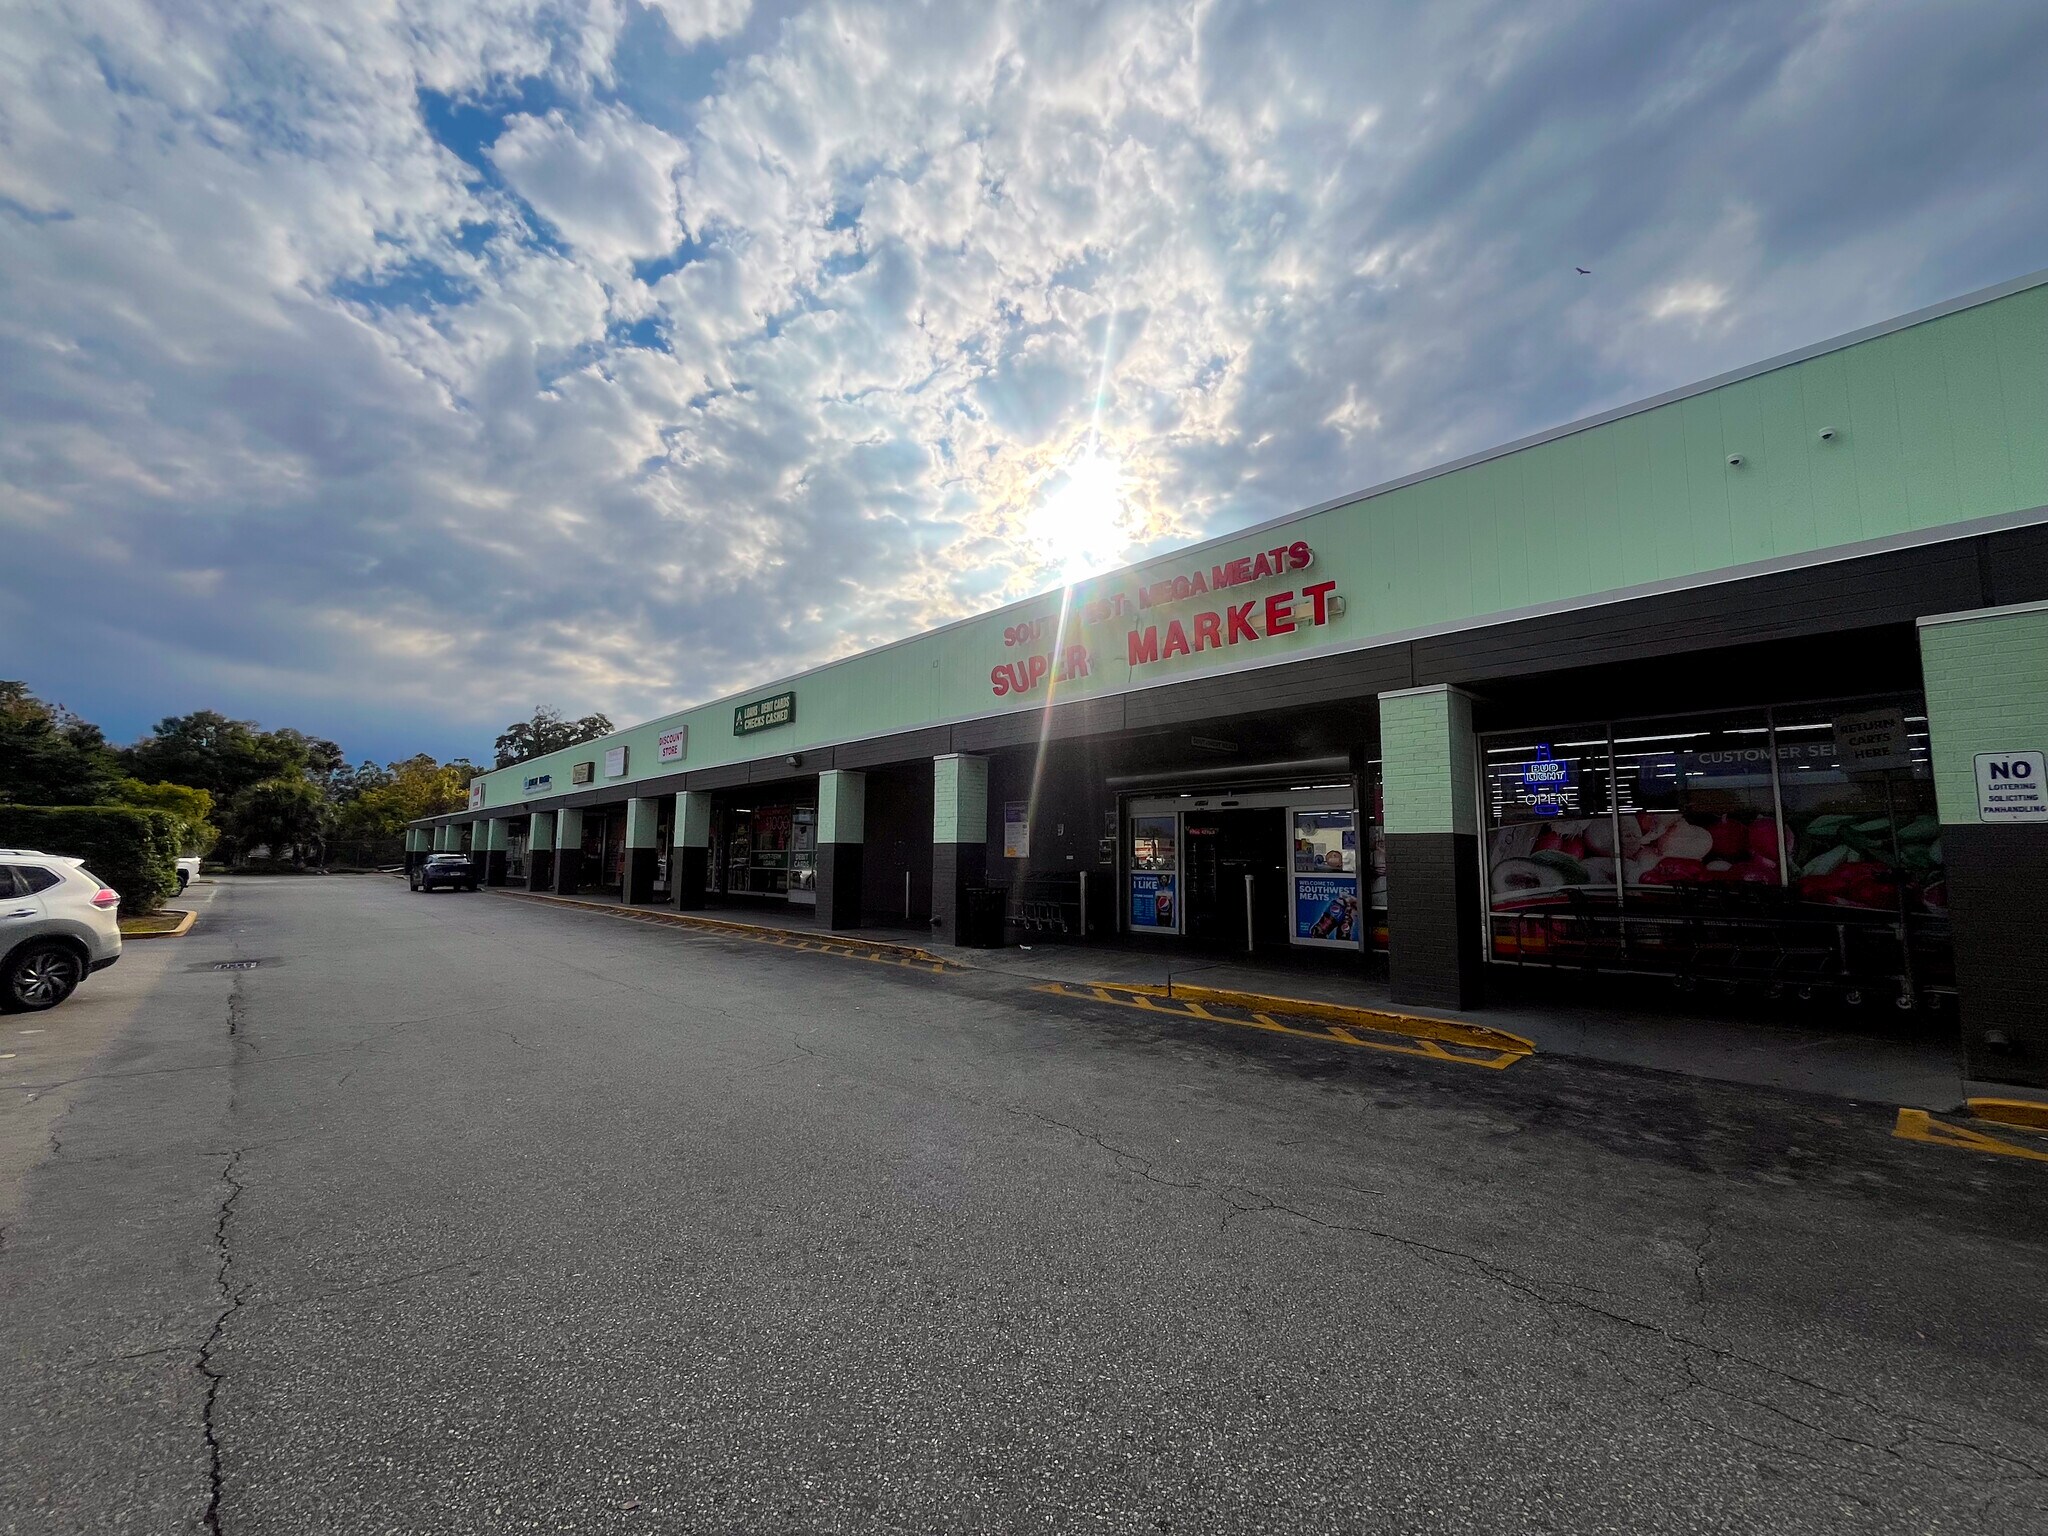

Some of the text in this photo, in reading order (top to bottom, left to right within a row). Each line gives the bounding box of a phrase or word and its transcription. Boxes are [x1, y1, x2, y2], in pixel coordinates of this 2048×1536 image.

[1139, 570, 1210, 610] MEGA
[1212, 541, 1313, 589] MEATS
[990, 581, 1336, 696] SUPER MARKET
[744, 709, 788, 730] CHECKS CASHED
[1839, 718, 1896, 734] RETURN
[659, 731, 683, 746] DISCOUNT
[1848, 732, 1892, 747] CARTS
[662, 745, 678, 757] STORE
[1854, 746, 1891, 760] HERE
[1531, 763, 1559, 773] BUD
[1989, 760, 2032, 780] NO
[1525, 772, 1565, 782] LIGHT
[1988, 782, 2037, 791] LOITERING
[1525, 793, 1569, 806] OPEN
[1988, 794, 2039, 802] SOLICITING
[1983, 805, 2047, 814] PANHANDLING
[1138, 880, 1158, 890] LIKE
[1299, 885, 1356, 895] SOUTHWEST
[1299, 892, 1330, 902] MEATS
